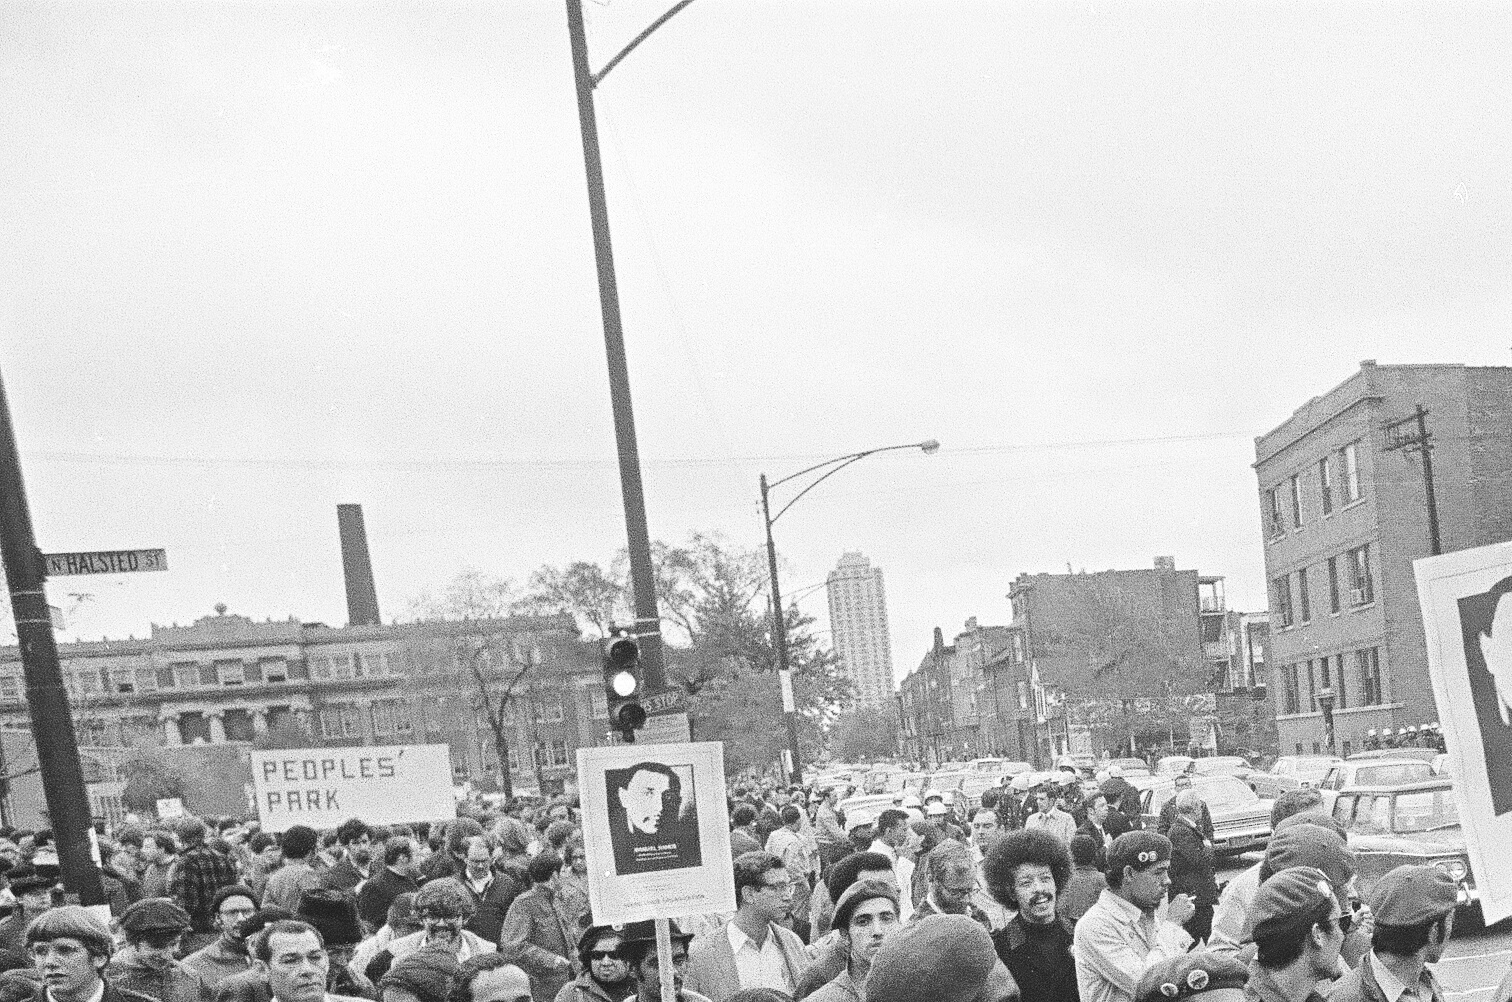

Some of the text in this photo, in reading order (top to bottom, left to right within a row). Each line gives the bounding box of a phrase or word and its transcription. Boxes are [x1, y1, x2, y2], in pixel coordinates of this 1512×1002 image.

[66, 551, 139, 575] HALSTED
[263, 749, 404, 782] PEOPLES'
[267, 789, 340, 813] PARK
